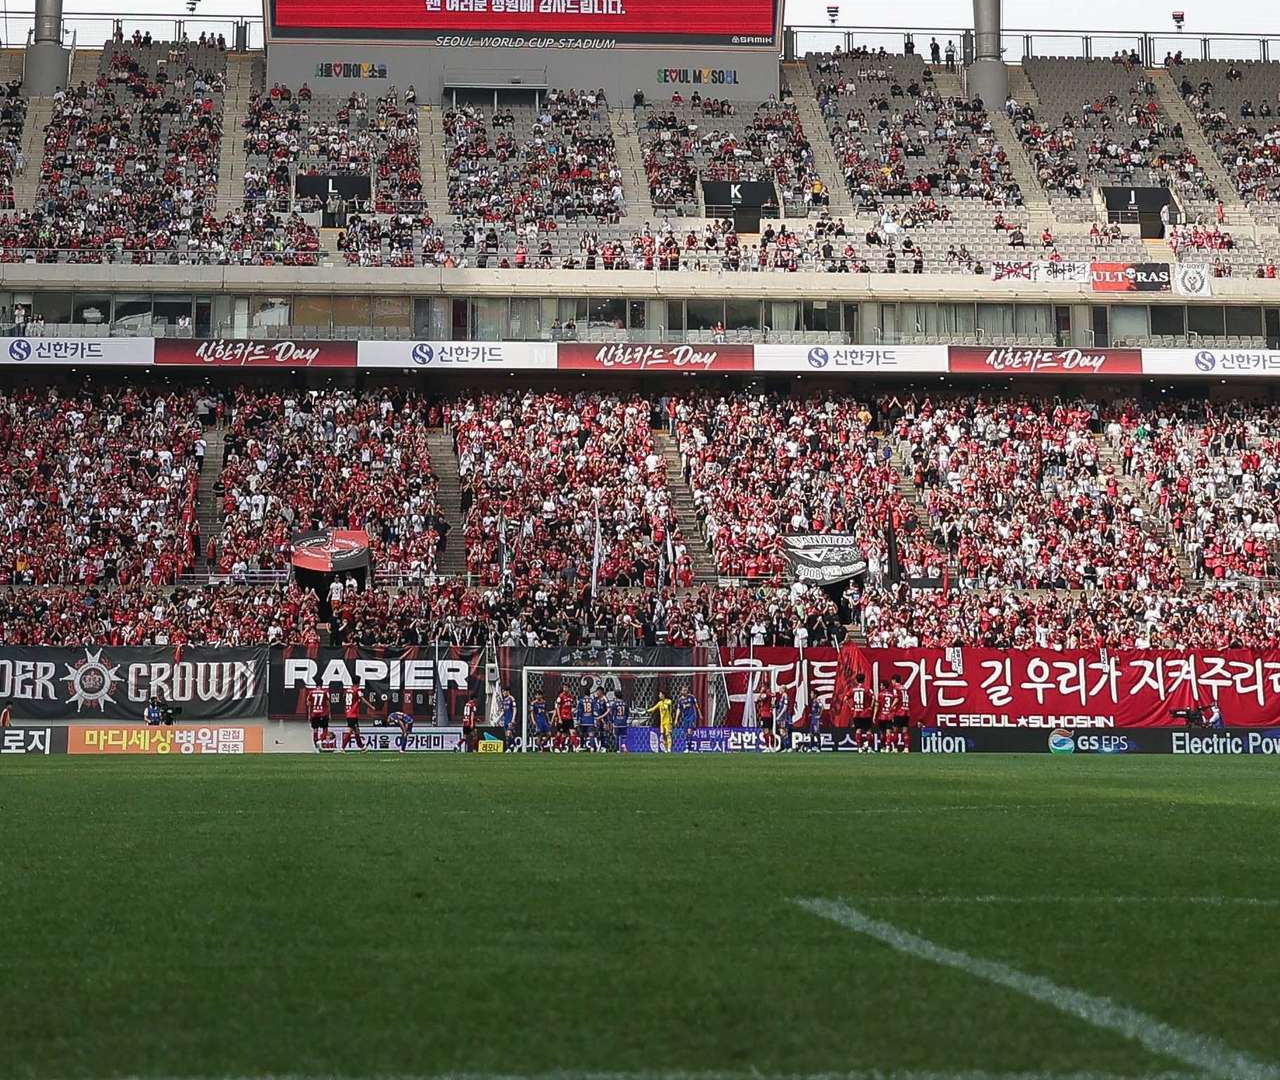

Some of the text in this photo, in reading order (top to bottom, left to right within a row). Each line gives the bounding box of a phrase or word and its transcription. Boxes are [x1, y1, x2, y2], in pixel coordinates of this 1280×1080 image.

[435, 36, 616, 49] SEOUL WORLD CUP STADIUM
[328, 178, 338, 192] L
[730, 184, 742, 198] K
[35, 342, 103, 359] 신한카드
[195, 339, 319, 365] 신한카드 Day
[438, 345, 504, 363] 신한카드
[595, 344, 718, 369] 신한카드 Day
[832, 349, 897, 366] 신한카드
[986, 347, 1107, 373] 신한카드 Day
[128, 660, 257, 701] CROWN
[284, 658, 469, 690] RAPIER
[893, 657, 969, 707] 가는
[980, 657, 1013, 706] 길
[1021, 657, 1122, 706] 우리가
[312, 694, 324, 705] 77
[936, 713, 1115, 728] FC SEOUL SUHOSHIN
[1077, 736, 1128, 750] GS EPS
[1172, 731, 1242, 754] Electric
